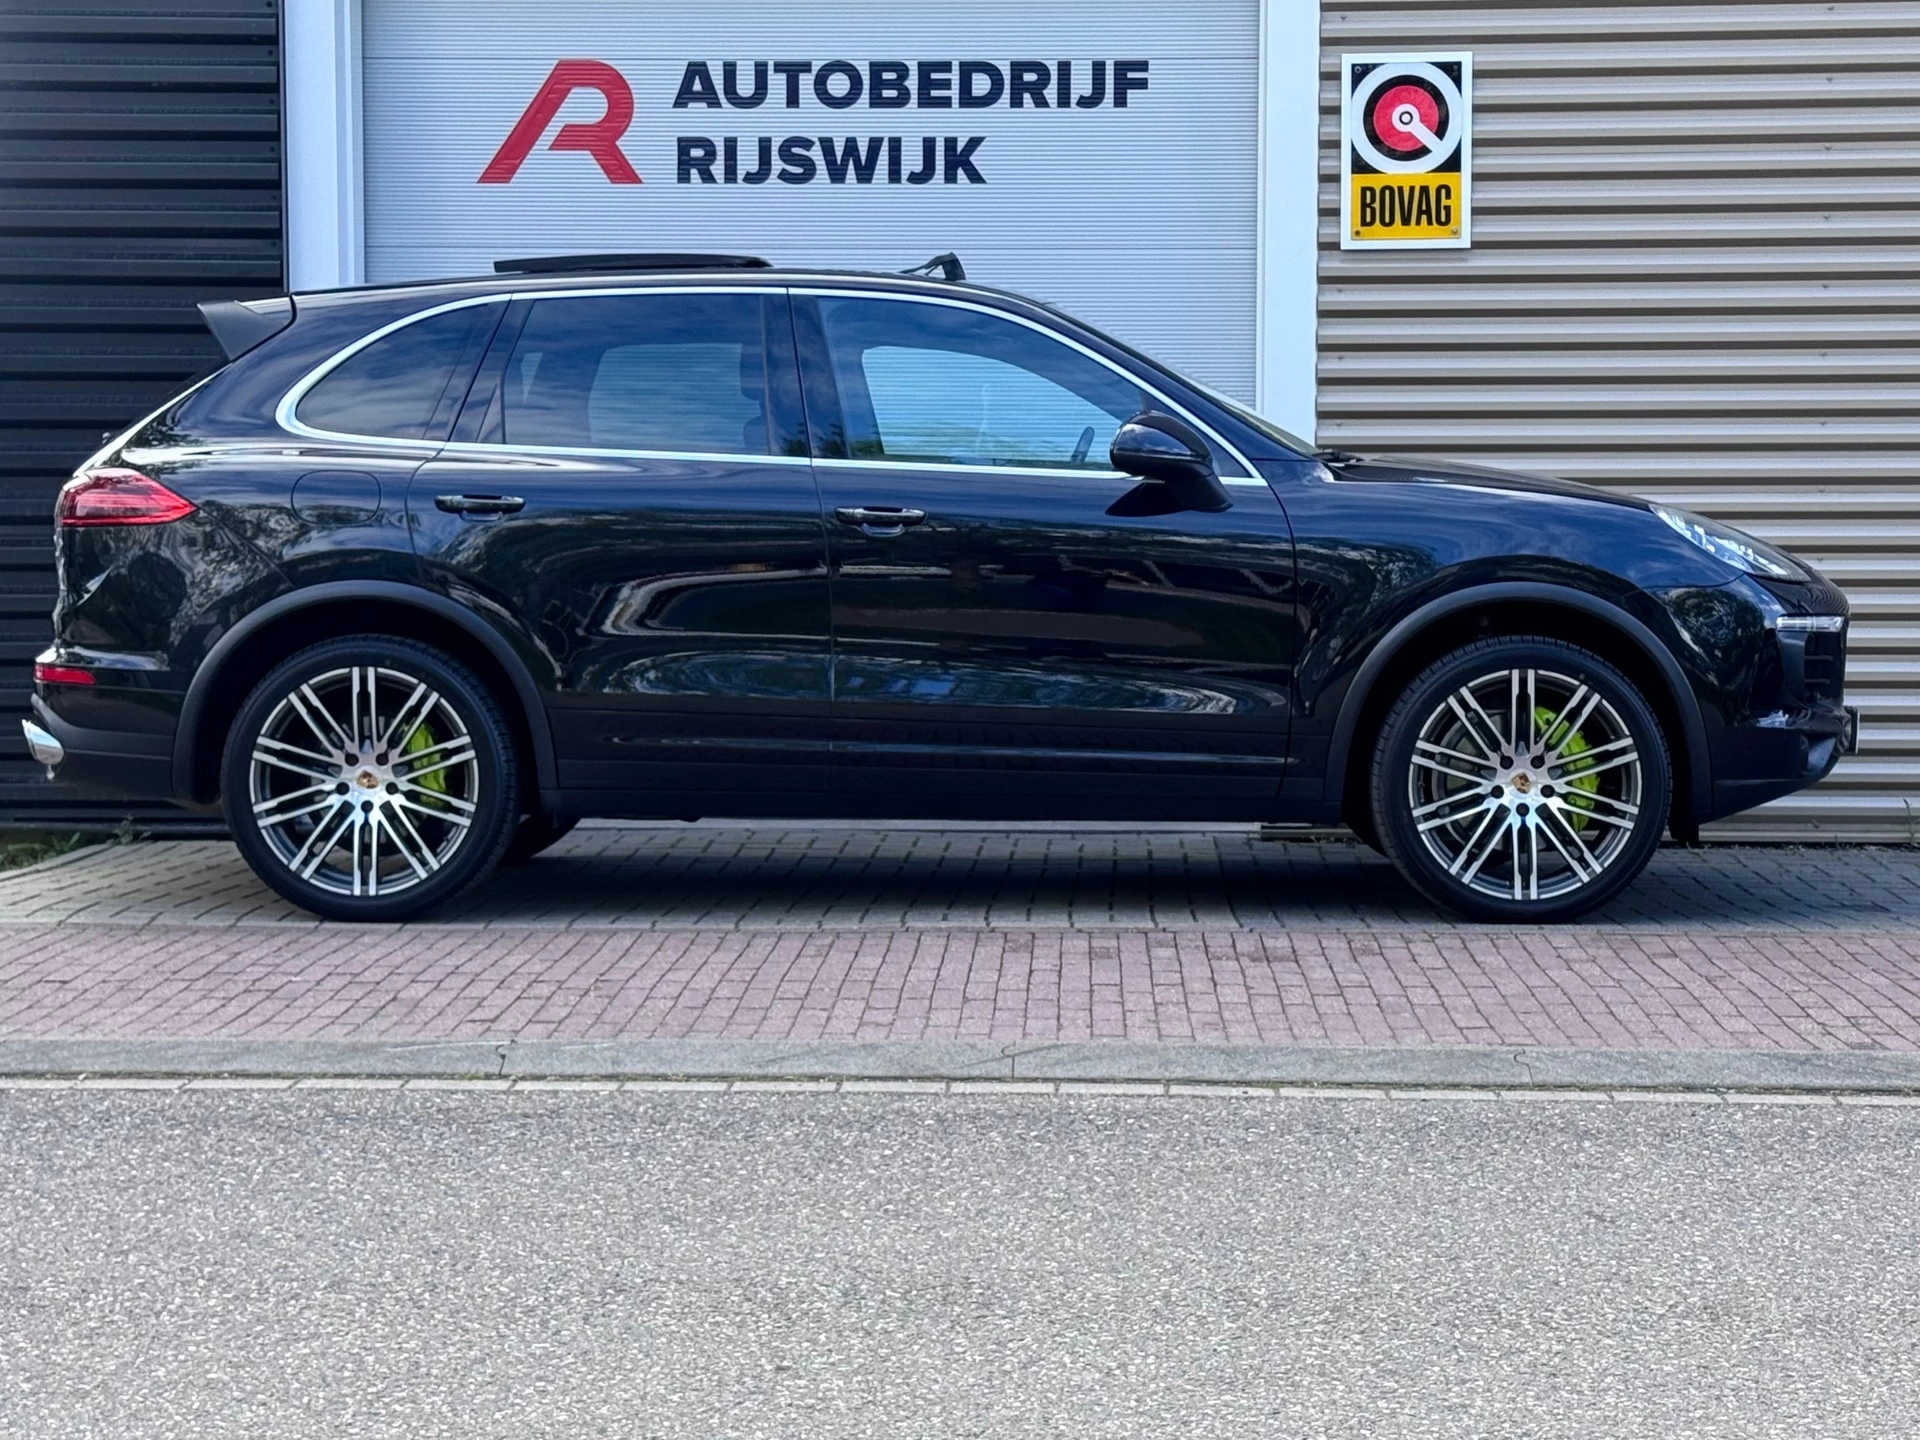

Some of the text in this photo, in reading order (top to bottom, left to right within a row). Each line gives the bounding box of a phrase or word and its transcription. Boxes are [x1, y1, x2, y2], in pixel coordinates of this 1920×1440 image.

[673, 60, 1150, 109] AUTOBEDRIJF
[676, 136, 987, 185] RIJSWIJK
[1360, 184, 1452, 228] BOVAG
